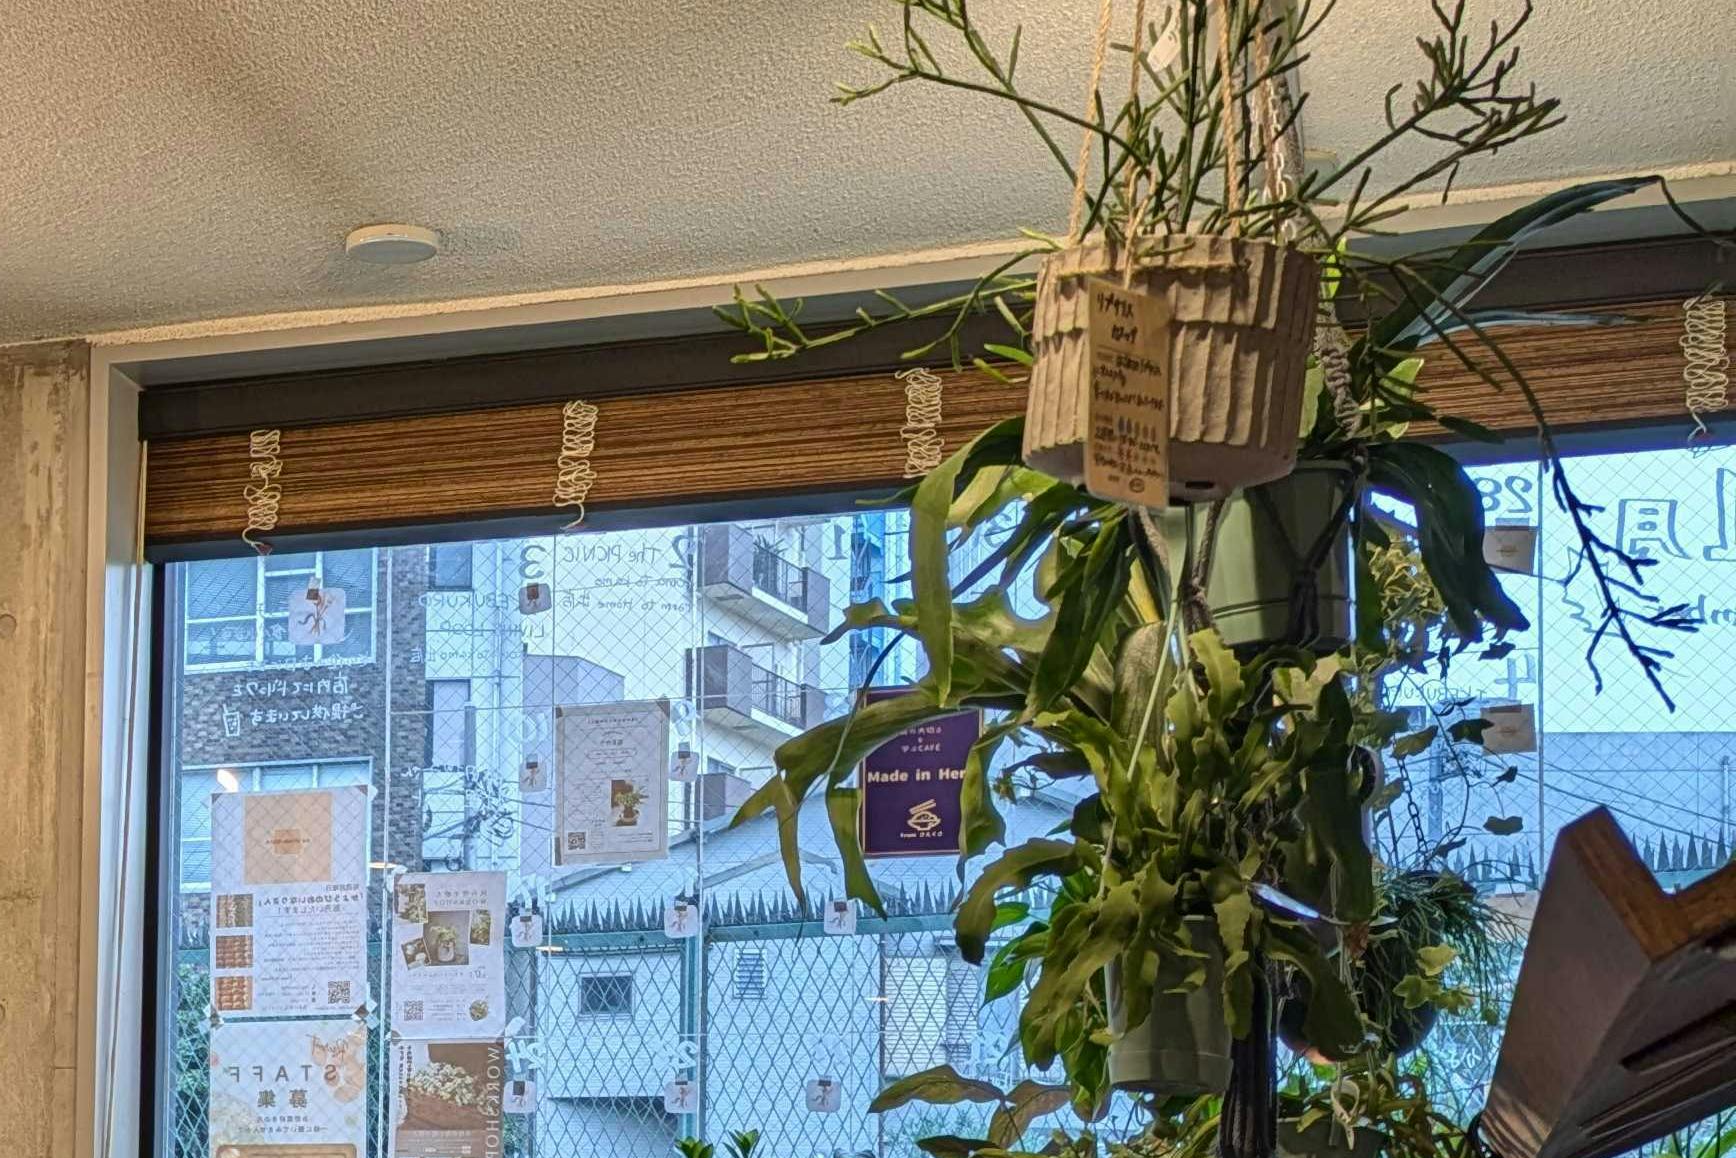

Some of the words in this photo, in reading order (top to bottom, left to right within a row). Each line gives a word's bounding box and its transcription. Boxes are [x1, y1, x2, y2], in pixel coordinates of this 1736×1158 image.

[867, 769, 910, 784] Made
[915, 768, 931, 782] in
[938, 766, 966, 782] Her
